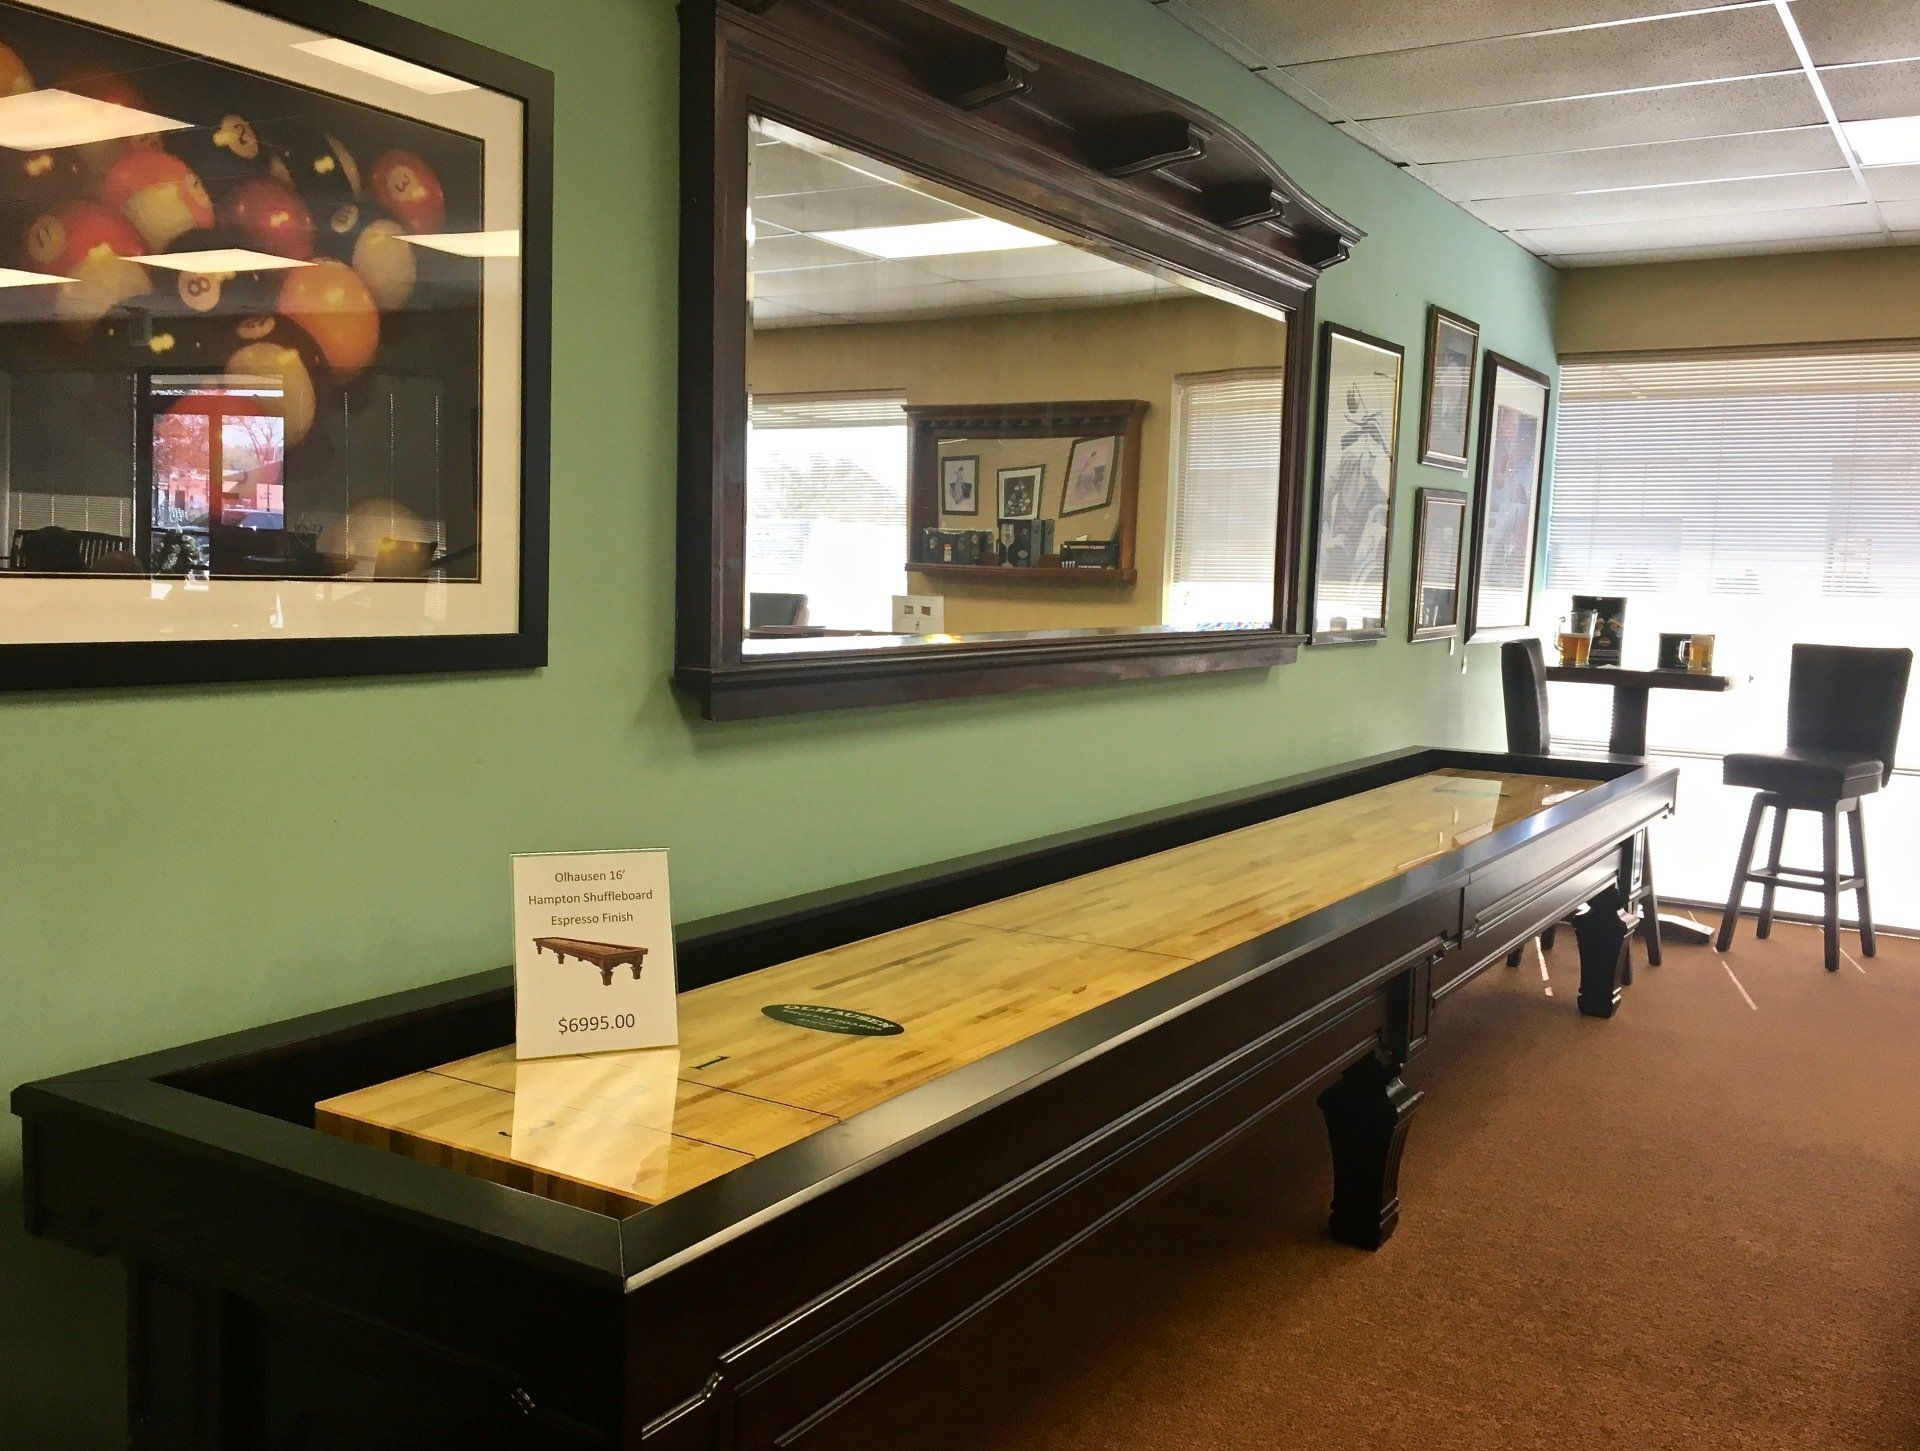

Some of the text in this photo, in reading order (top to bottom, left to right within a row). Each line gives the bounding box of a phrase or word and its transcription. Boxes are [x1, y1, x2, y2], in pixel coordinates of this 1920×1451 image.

[395, 174, 410, 192] 3
[187, 277, 211, 297] 8
[554, 871, 606, 883] Olhausen
[528, 889, 653, 906] Hampton Shuffleboard
[551, 911, 634, 926] Espresso Finish
[558, 1013, 635, 1035] $6995.00
